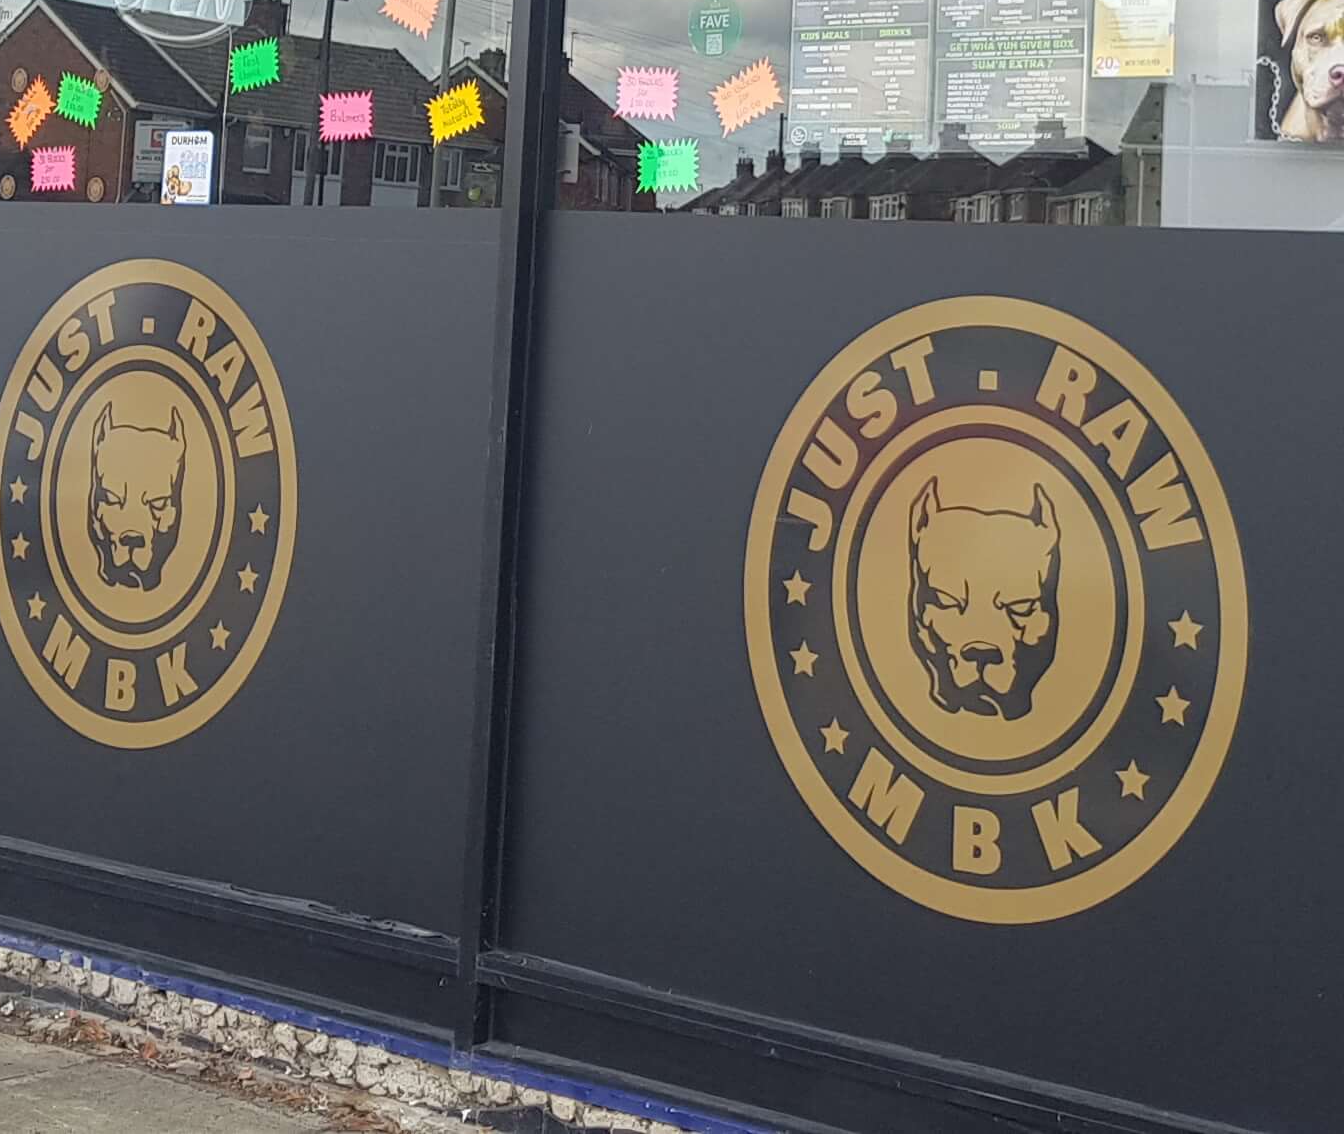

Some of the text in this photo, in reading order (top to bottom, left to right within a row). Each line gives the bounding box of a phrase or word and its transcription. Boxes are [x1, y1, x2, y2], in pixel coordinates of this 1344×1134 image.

[700, 15, 730, 29] FAVE
[950, 42, 968, 51] GET
[1020, 41, 1050, 50] GIVEN
[1009, 59, 1044, 69] EXTRA
[440, 98, 466, 115] Totally
[330, 109, 366, 123] Bulmers
[15, 290, 273, 460] JUST RAW
[786, 336, 1204, 552] JUST RAW
